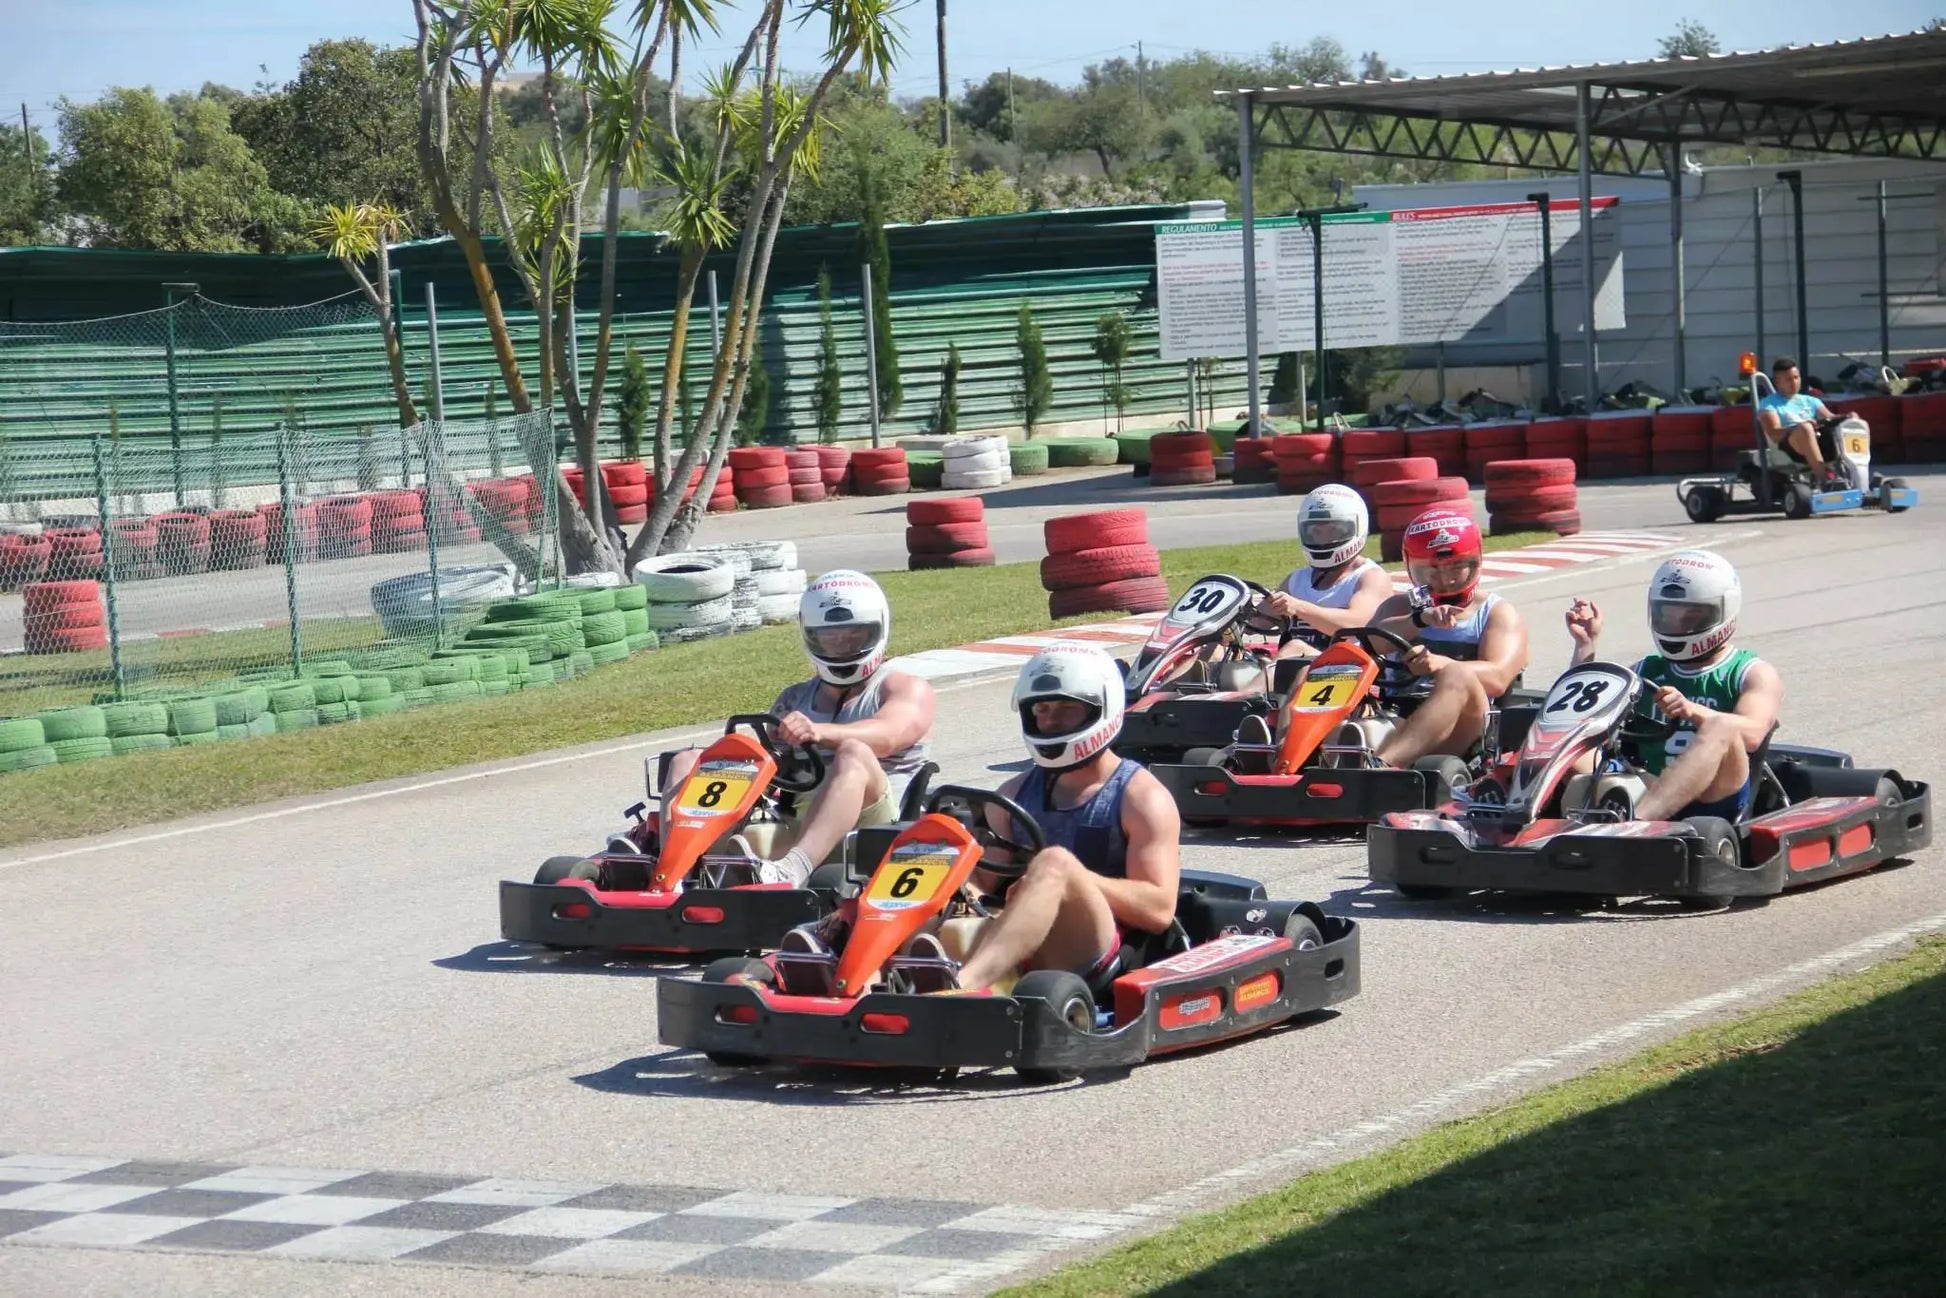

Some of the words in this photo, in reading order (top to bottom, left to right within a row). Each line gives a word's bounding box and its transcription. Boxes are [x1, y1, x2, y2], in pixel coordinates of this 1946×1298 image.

[1161, 223, 1217, 234] REGULAMENTO
[1852, 438, 1861, 453] 6
[1178, 587, 1225, 613] 30
[1309, 685, 1335, 706] 4
[1546, 680, 1609, 713] 28
[698, 781, 727, 808] 8
[890, 867, 924, 898] 6
